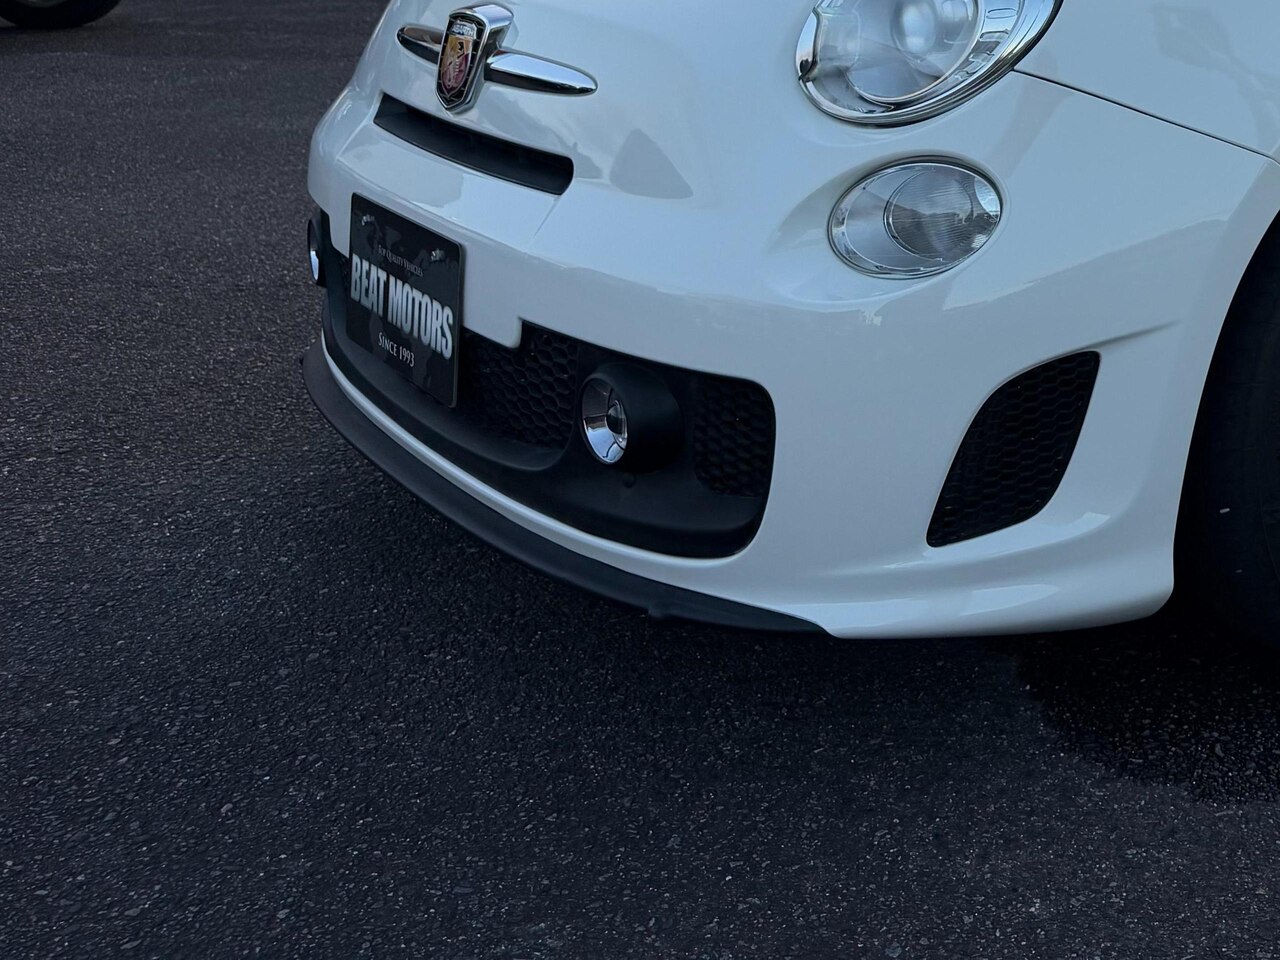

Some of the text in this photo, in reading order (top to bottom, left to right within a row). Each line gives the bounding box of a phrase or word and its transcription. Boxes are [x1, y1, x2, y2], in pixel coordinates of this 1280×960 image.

[351, 253, 453, 360] BEAT MOTORS
[378, 331, 415, 368] SINCE 1993
